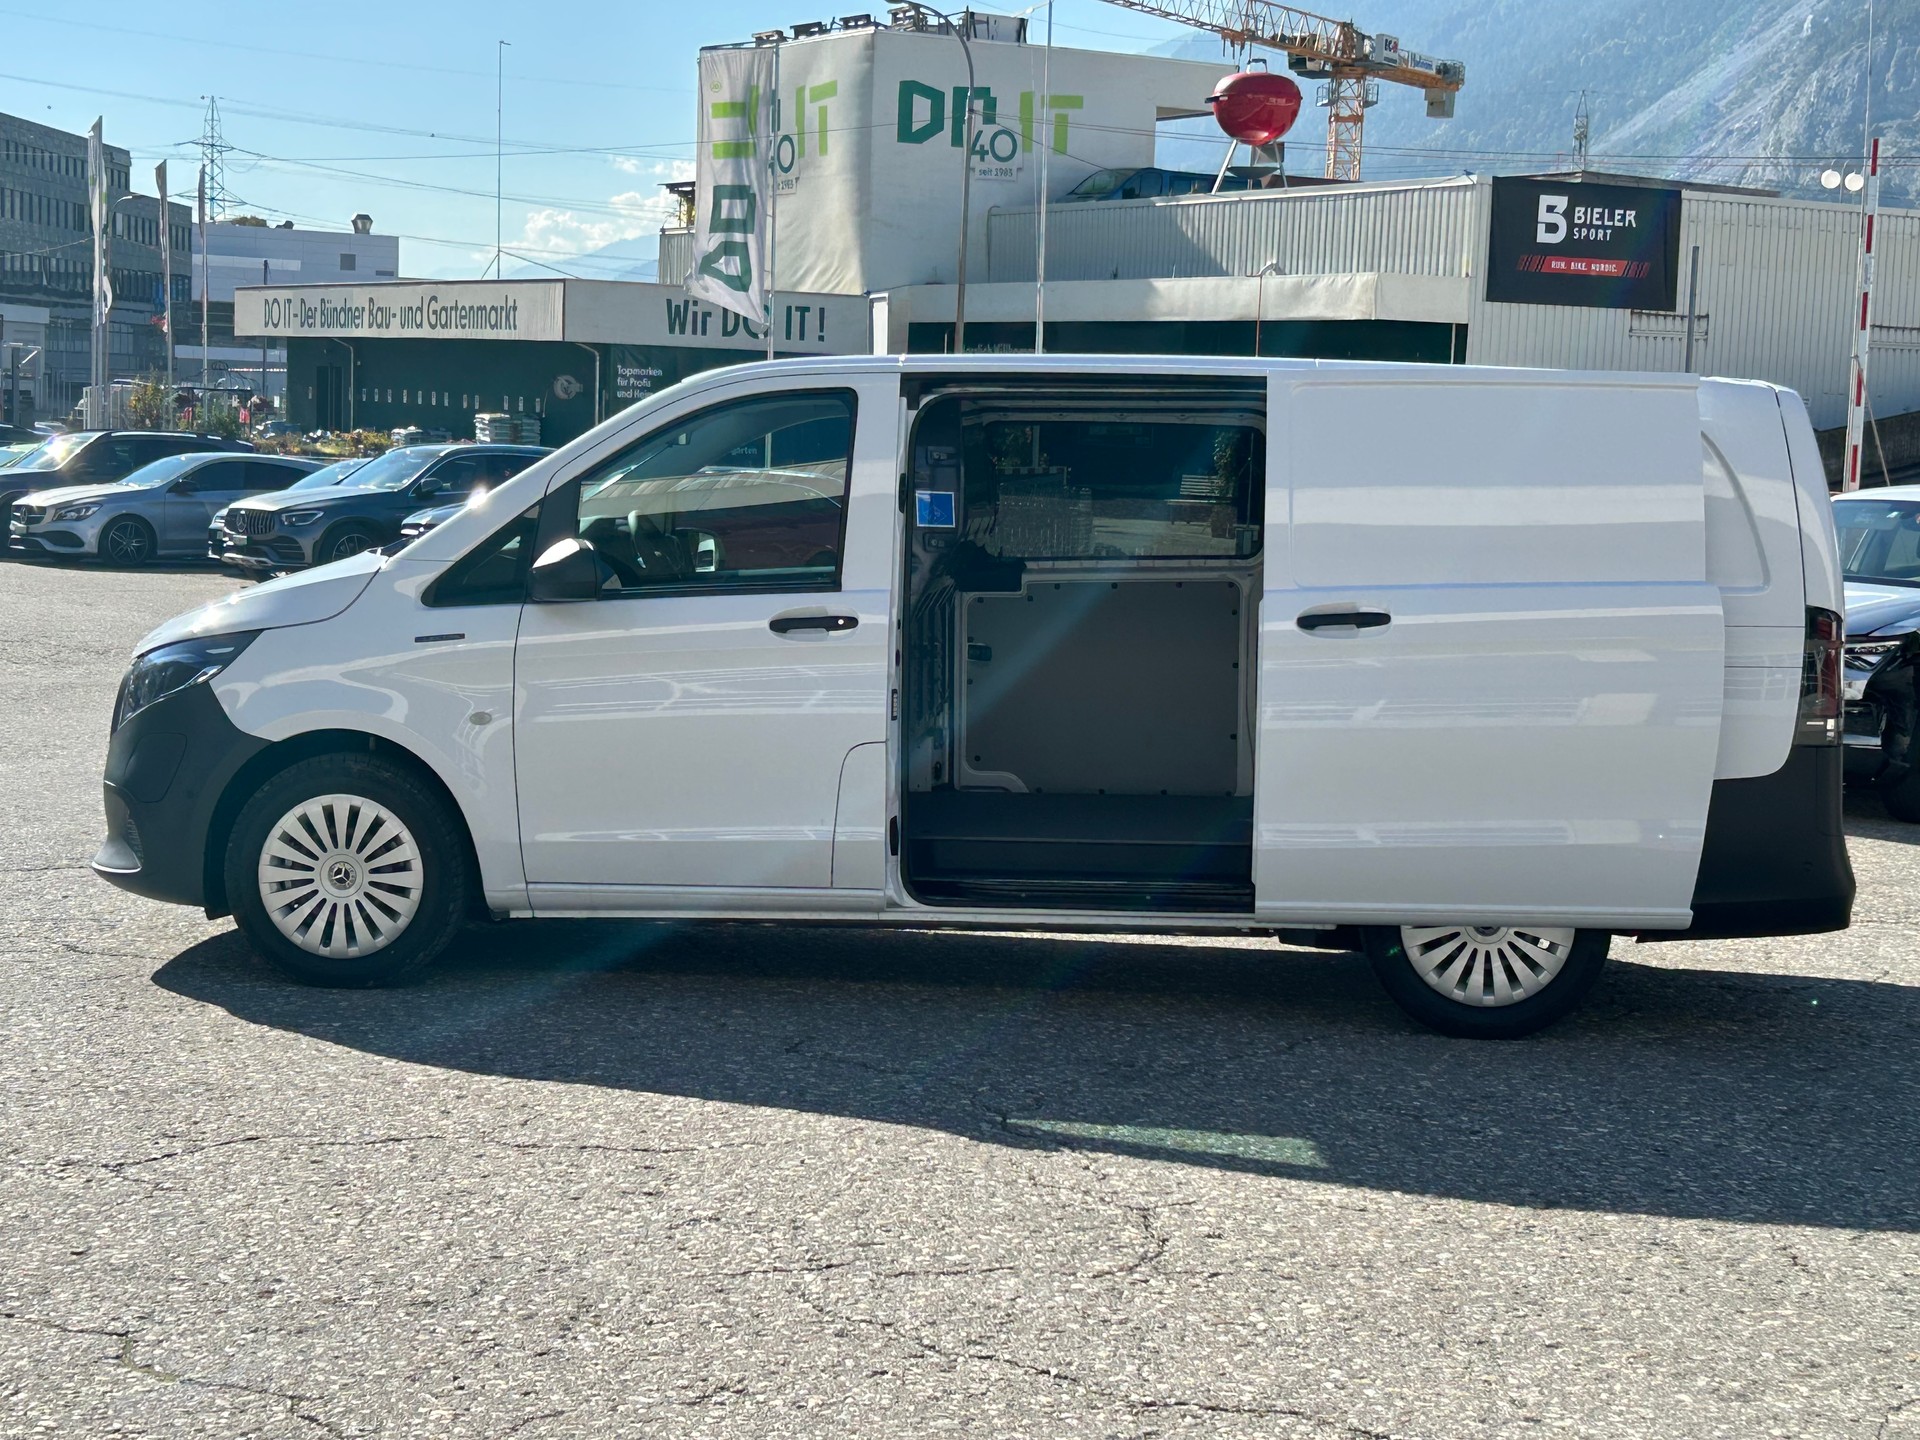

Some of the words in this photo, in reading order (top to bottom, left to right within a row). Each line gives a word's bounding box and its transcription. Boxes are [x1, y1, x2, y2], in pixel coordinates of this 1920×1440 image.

[1019, 91, 1084, 155] IT
[971, 129, 1018, 163] 40
[1574, 206, 1637, 228] BIELER
[1573, 227, 1612, 241] SPORT
[264, 297, 281, 329] DO
[320, 297, 366, 329] Bündner
[368, 296, 397, 330] Bau-
[400, 295, 423, 330] und
[427, 294, 518, 331] Gartenmarkt
[666, 298, 712, 336] Wir
[617, 364, 663, 377] Topmarken
[617, 377, 628, 387] für
[629, 377, 651, 388] Profis
[617, 389, 633, 399] und
